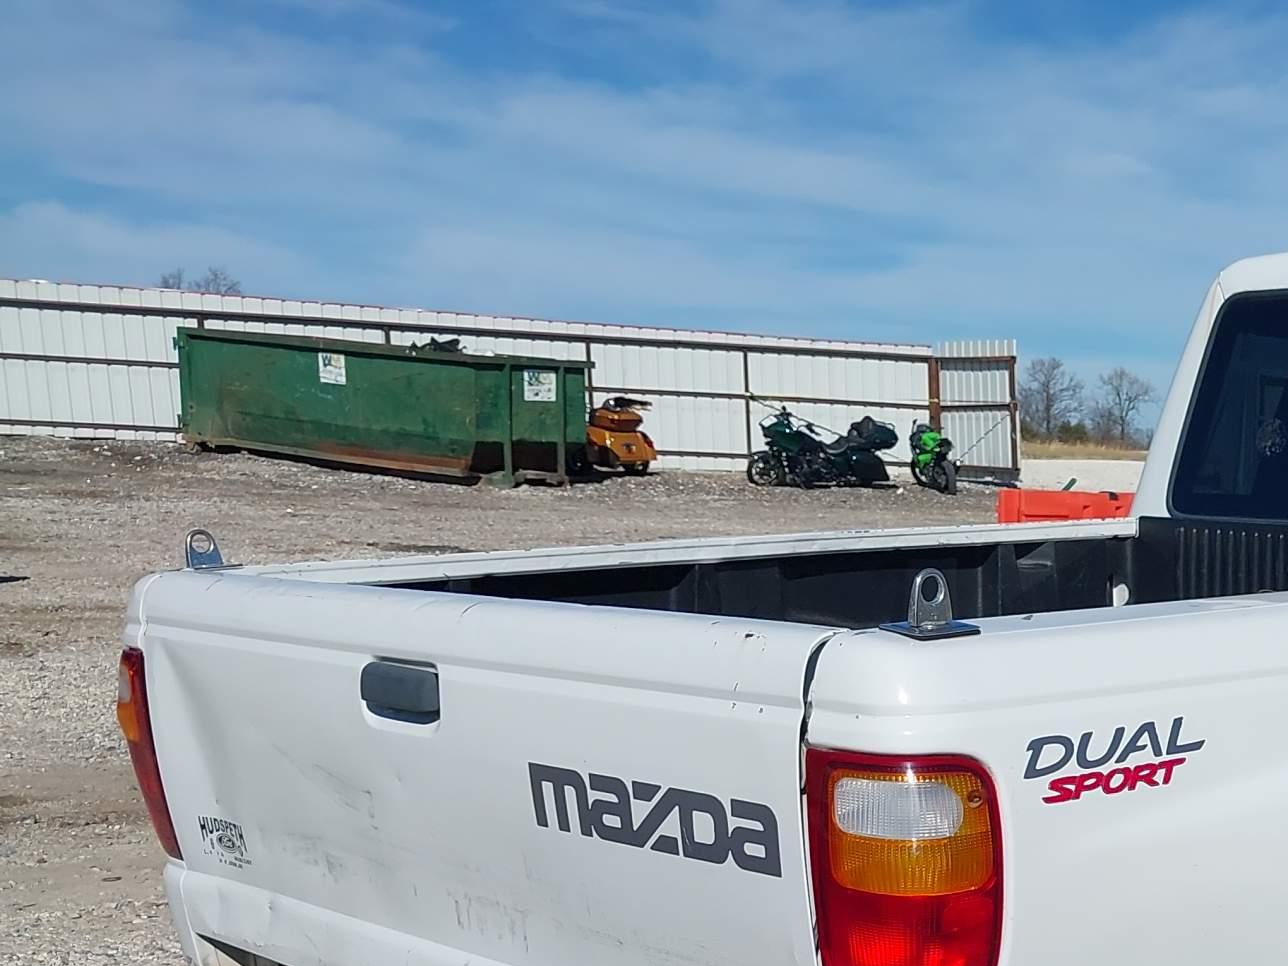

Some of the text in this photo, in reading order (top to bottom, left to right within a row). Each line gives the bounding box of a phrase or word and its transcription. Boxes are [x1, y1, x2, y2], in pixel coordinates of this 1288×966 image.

[1023, 716, 1206, 780] DUAL
[1041, 757, 1187, 804] SPORT
[197, 815, 248, 853] HUDSPETH
